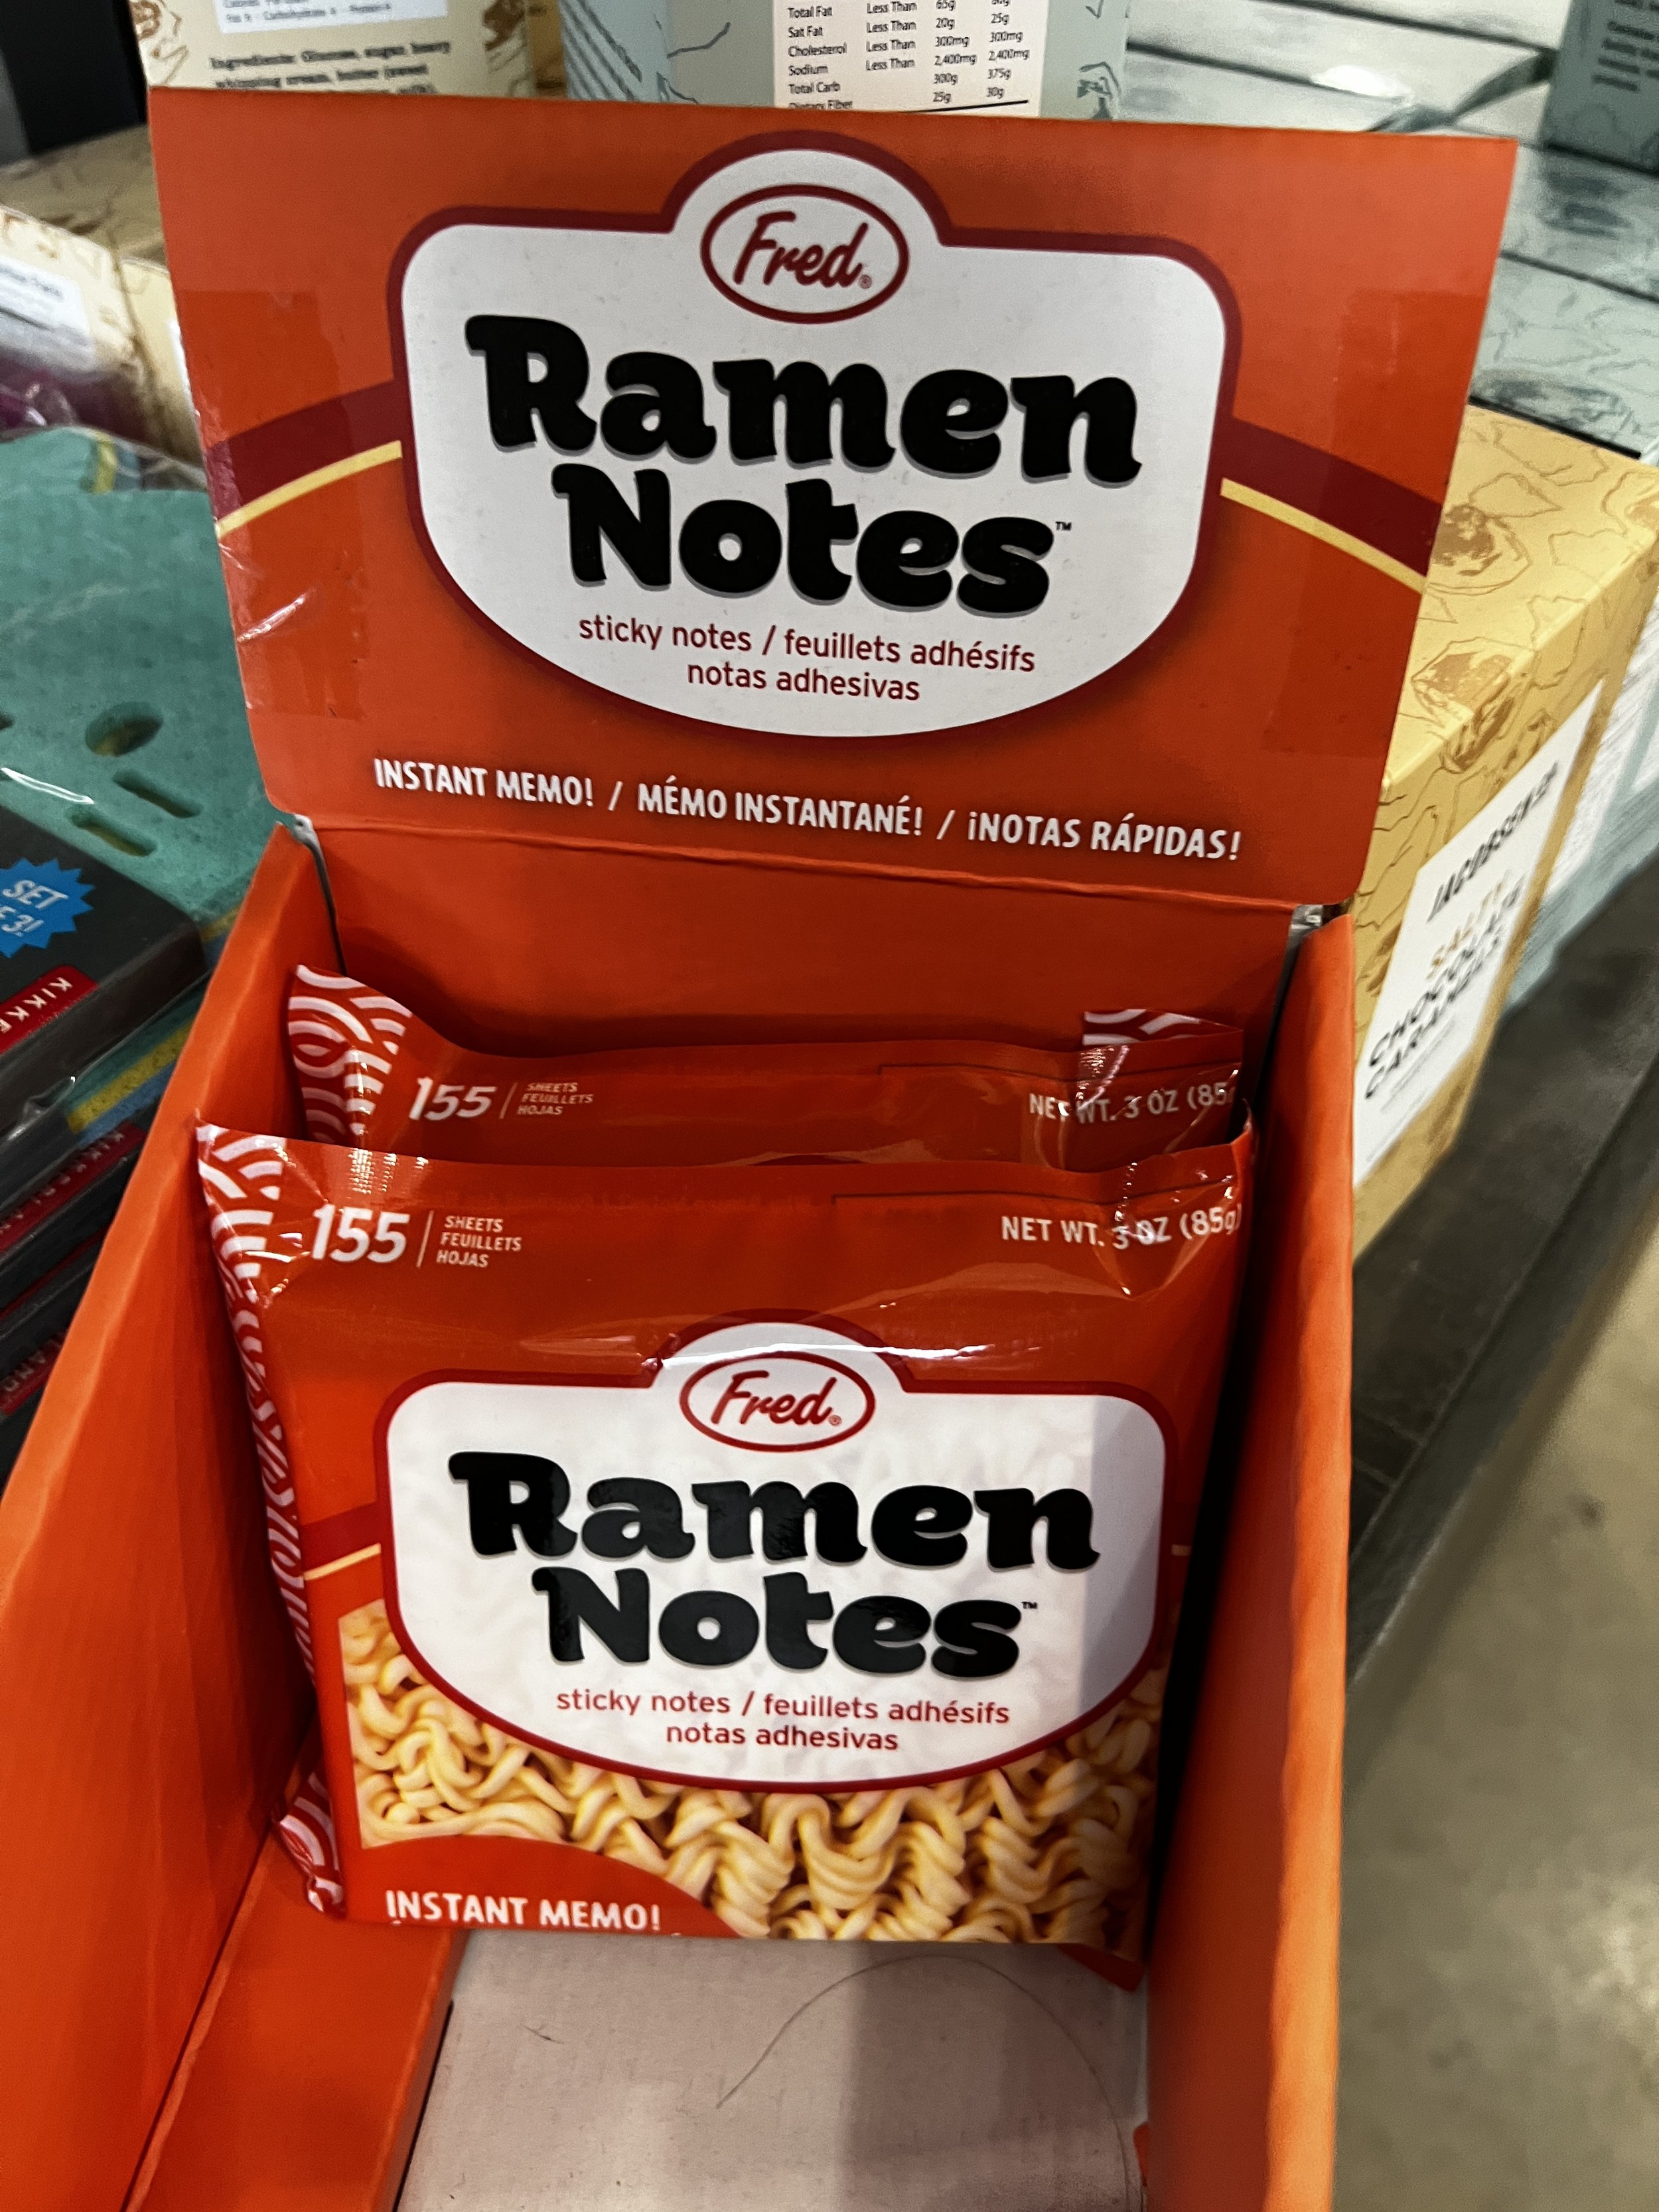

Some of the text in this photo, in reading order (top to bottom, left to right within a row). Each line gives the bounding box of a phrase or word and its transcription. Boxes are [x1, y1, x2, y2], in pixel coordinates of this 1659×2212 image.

[788, 6, 814, 18] Total
[816, 5, 833, 17] Fat
[867, 3, 889, 13] Less
[891, 1, 918, 12] Than
[788, 13, 1010, 38] Sat Fat Less Than 20g 25g
[788, 31, 1023, 57] Cholesterol Less Than 300mg 300mg
[788, 64, 829, 76] Sodium
[866, 60, 888, 71] Less
[889, 58, 916, 69] Than
[788, 82, 814, 94] Total
[816, 81, 841, 92] Carb
[933, 92, 952, 104] 25g
[987, 87, 1005, 99] 30g
[464, 314, 1143, 488] Ramen
[578, 615, 662, 650] sticky
[672, 623, 752, 652] notes
[784, 628, 901, 664] feuillets
[910, 638, 1036, 672] adhésifs
[687, 662, 920, 701] notas adhesivas
[373, 758, 488, 796] INSTANT
[496, 769, 595, 808] MEMO!
[637, 775, 729, 820] MÉMO
[735, 792, 923, 837] INSTANTANÉ!
[1090, 812, 1242, 861] RÁPIDAS!
[2, 879, 68, 910] SET
[408, 1076, 498, 1121] 155
[522, 1092, 594, 1105] FEUILLETS
[526, 1081, 579, 1093] SHEETS
[516, 1104, 563, 1116] HOJAS
[1147, 1088, 1180, 1116] OZ
[311, 1203, 410, 1264] 155
[444, 1215, 504, 1233] SHEETS
[1001, 1216, 1053, 1242] NET
[1060, 1219, 1106, 1248] WT.
[1135, 1216, 1173, 1246] OZ
[1179, 1203, 1243, 1241] (85g)
[439, 1231, 523, 1252] FEUILLETS
[435, 1250, 490, 1268] HOJAS
[448, 1451, 1102, 1573] Ramen
[556, 1688, 641, 1716] sticky
[650, 1690, 731, 1714] notes
[763, 1692, 879, 1721] feuillets
[888, 1698, 1011, 1726] adhésifs
[666, 1722, 899, 1751] notas adhesivas
[385, 1889, 662, 1932] INSTANT MEMO!
